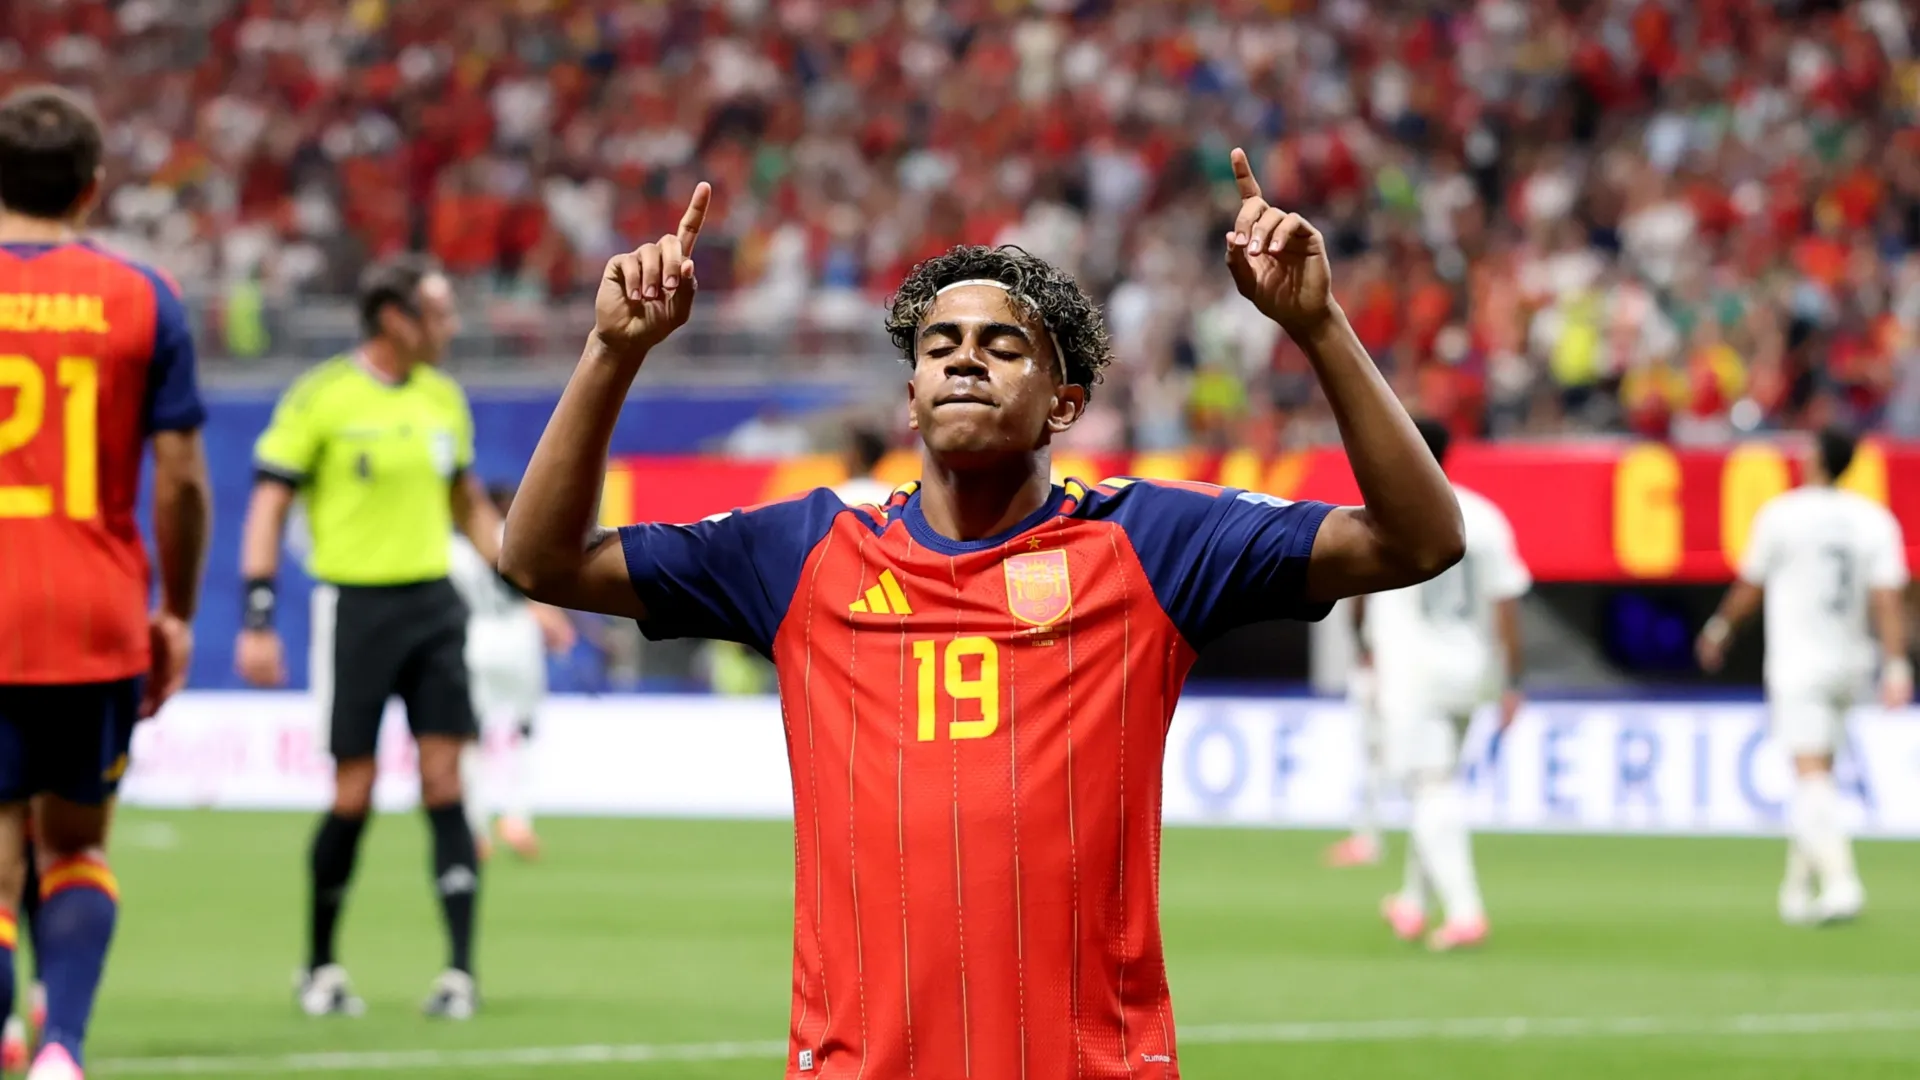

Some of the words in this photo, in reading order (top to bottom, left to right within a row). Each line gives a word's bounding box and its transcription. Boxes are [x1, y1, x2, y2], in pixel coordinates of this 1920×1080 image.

[0, 354, 98, 520] 21
[912, 635, 999, 742] 19
[1184, 720, 1307, 808] OF
